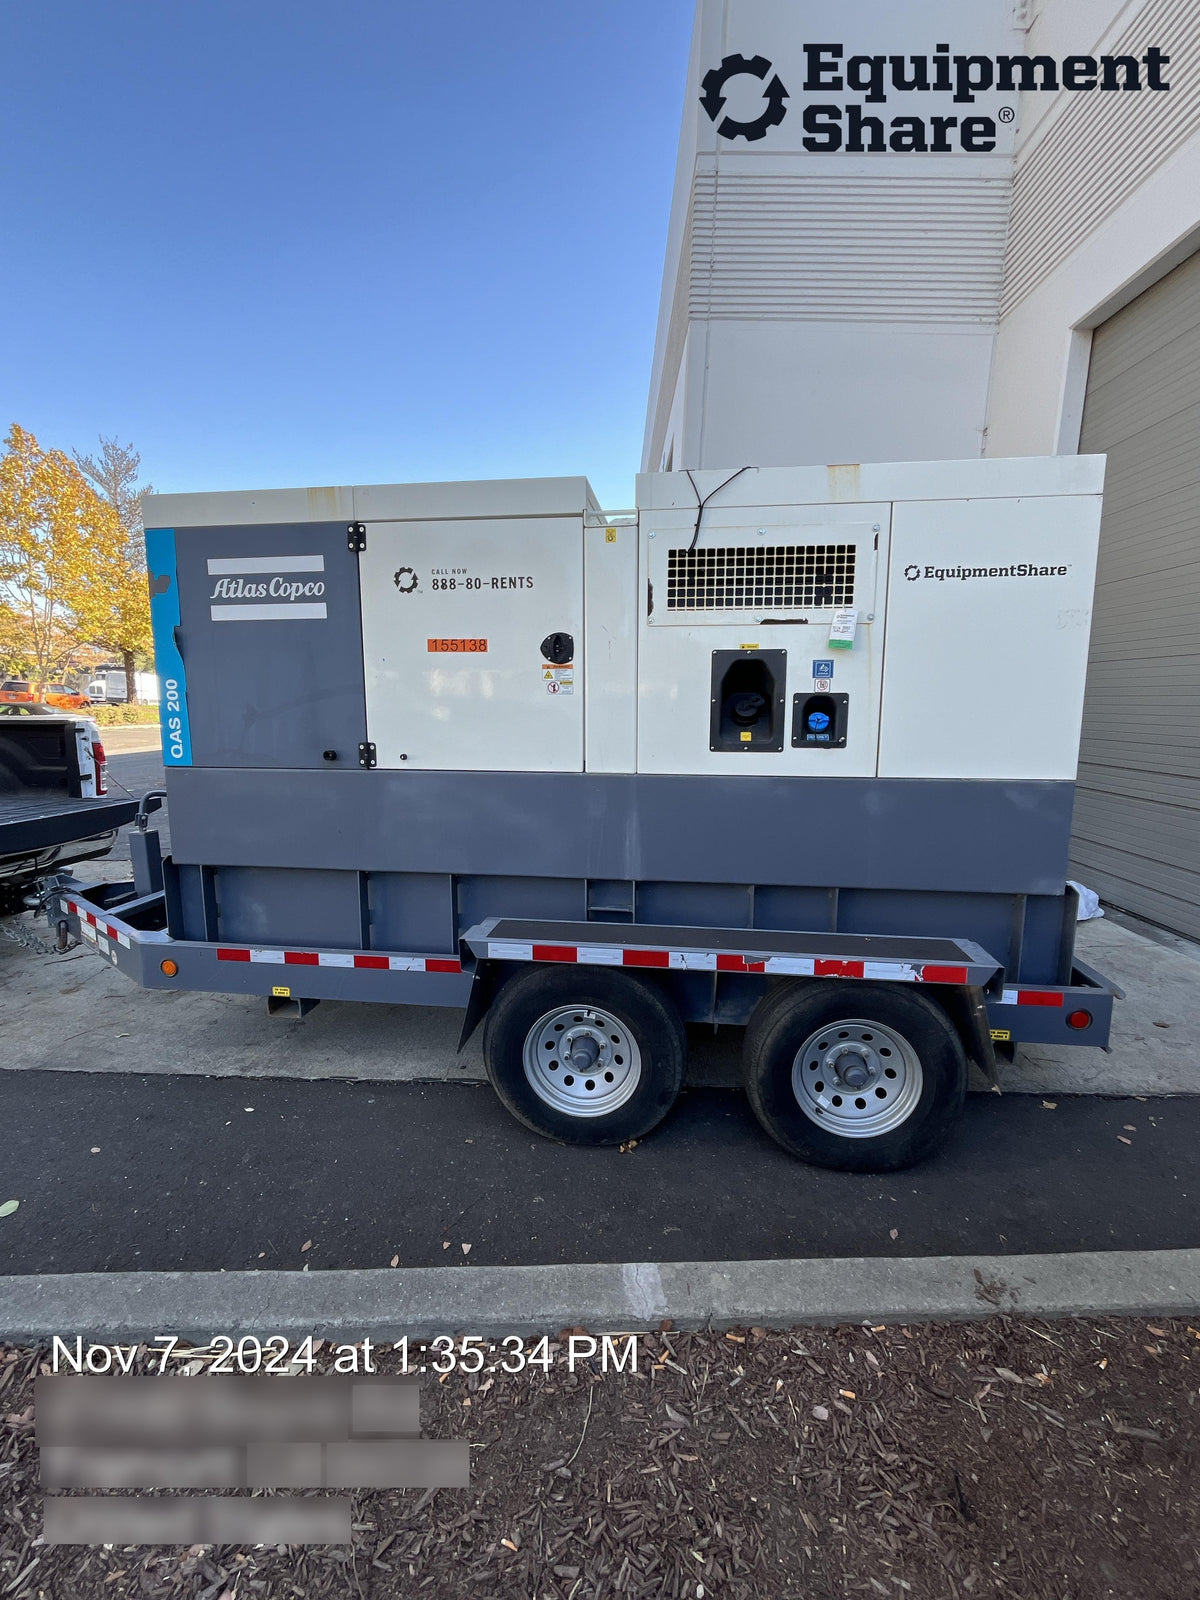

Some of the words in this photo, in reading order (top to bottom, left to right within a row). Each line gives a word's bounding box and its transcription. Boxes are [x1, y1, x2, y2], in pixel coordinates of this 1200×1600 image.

[432, 576, 534, 590] 888-80-RENTS
[924, 564, 1068, 581] EquipmentShare
[210, 578, 267, 599] Atlas
[269, 576, 325, 601] Copco
[431, 639, 488, 652] 155138
[165, 679, 180, 711] 200
[168, 717, 183, 759] QAS
